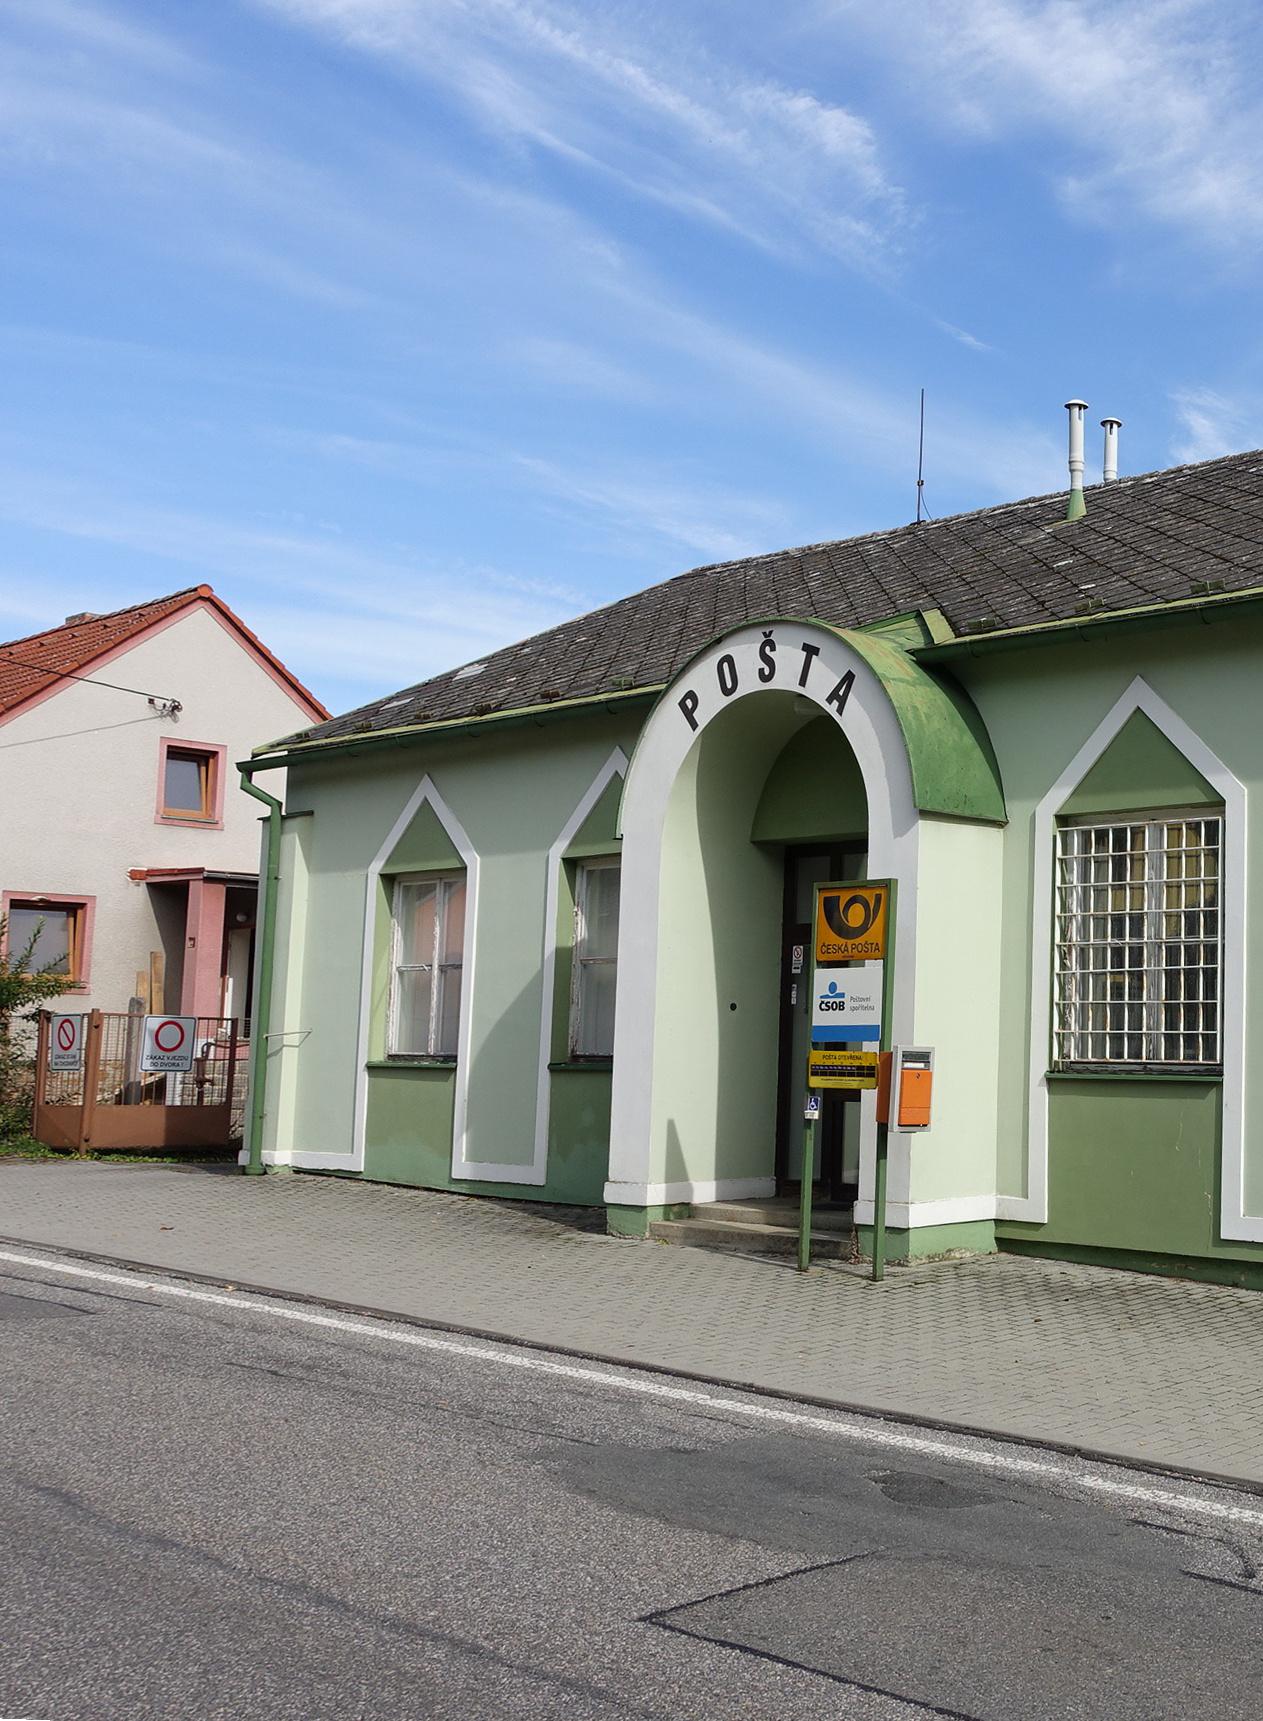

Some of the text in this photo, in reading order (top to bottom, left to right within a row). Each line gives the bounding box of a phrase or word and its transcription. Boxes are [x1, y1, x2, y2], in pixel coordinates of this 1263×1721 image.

[678, 630, 856, 732] POŠTA
[820, 941, 880, 954] ČESKÁ POŠTA
[818, 1000, 846, 1012] ČSOB
